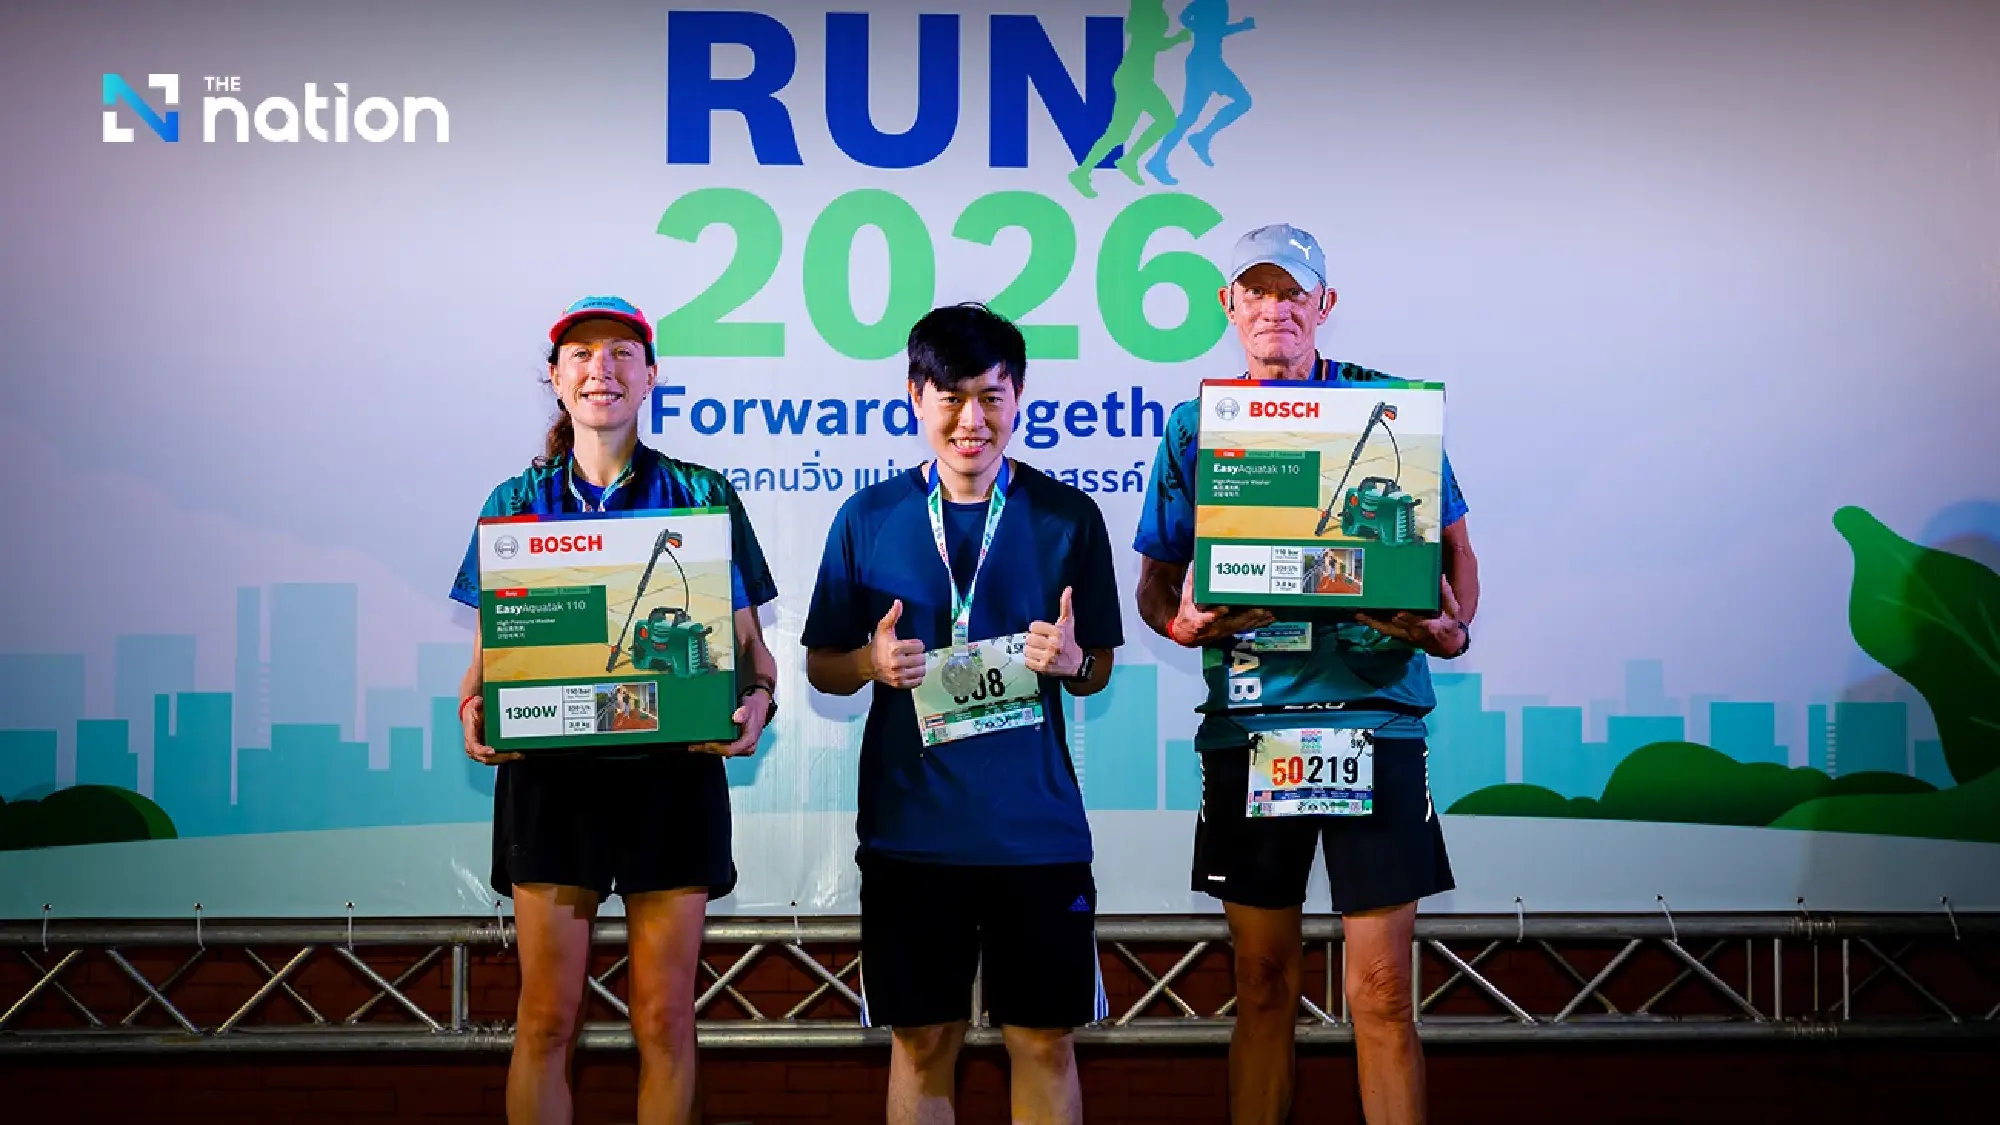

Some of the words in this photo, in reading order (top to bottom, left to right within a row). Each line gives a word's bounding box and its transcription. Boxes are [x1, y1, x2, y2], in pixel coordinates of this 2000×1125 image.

[666, 10, 1124, 169] RUN
[656, 187, 1228, 363] 2026
[651, 386, 918, 435] Forward
[1012, 386, 1188, 449] geth
[1249, 401, 1320, 418] BOSCH
[1281, 464, 1300, 474] 110
[529, 534, 603, 555] BOSCH
[1215, 562, 1266, 575] 1300W
[566, 600, 586, 610] 110
[505, 705, 557, 720] 1300W
